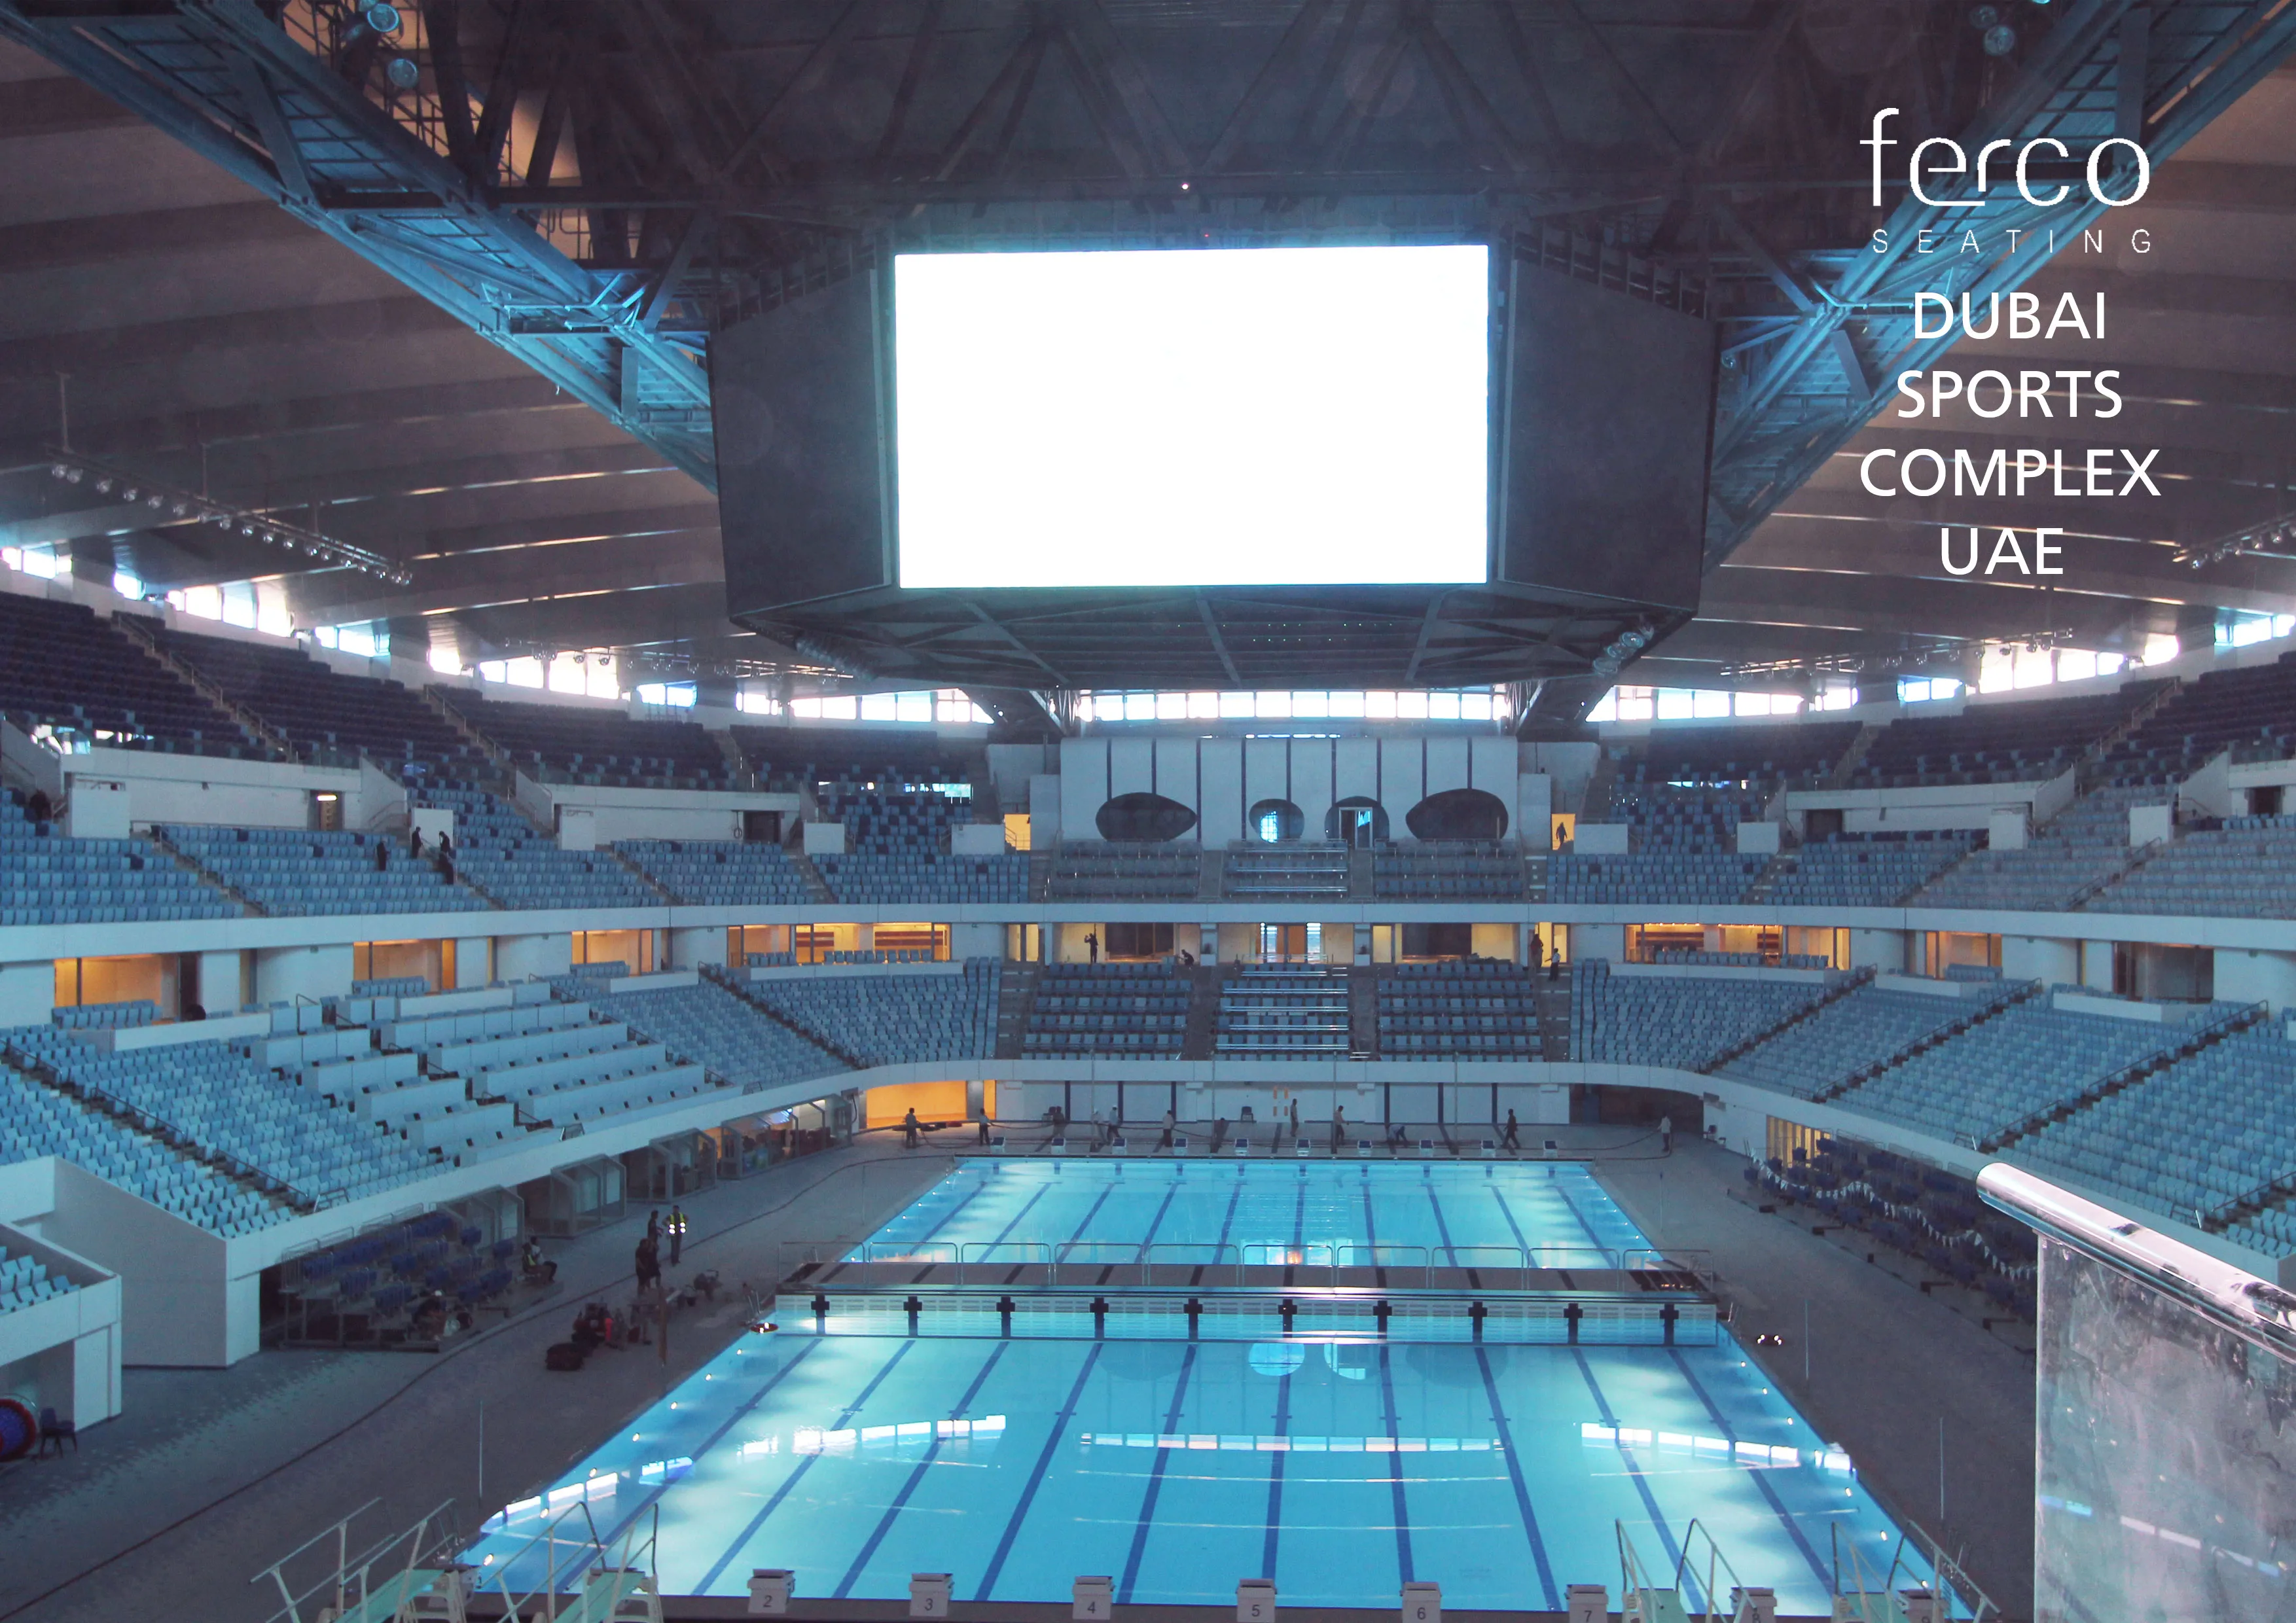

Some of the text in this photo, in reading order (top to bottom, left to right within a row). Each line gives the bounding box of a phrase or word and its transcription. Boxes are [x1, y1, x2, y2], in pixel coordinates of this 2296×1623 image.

[763, 1595, 772, 1607] 2
[924, 1598, 933, 1611] 3
[1087, 1601, 1096, 1614] 4
[1251, 1605, 1260, 1617] 5
[1417, 1607, 1426, 1620] 6
[1585, 1610, 1592, 1622] 7
